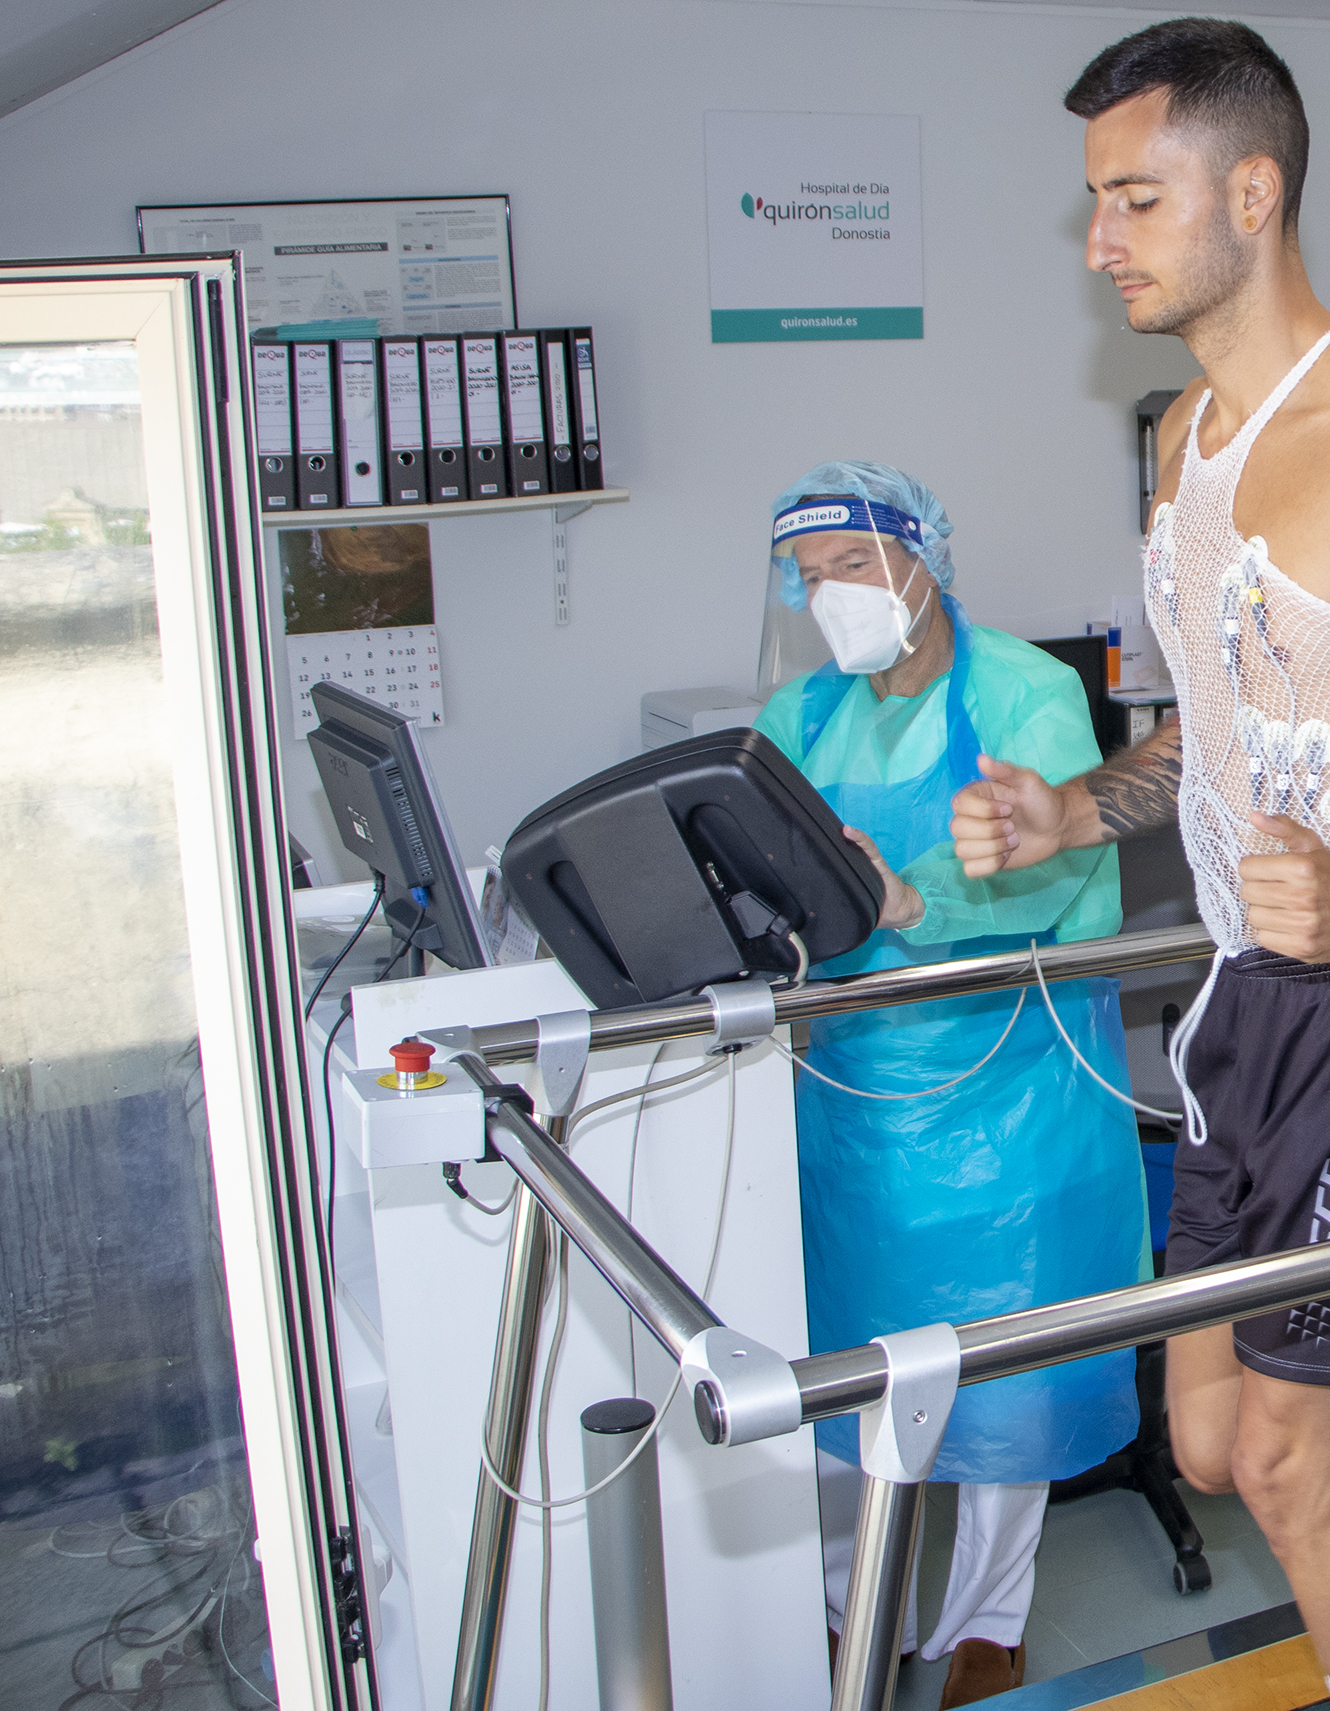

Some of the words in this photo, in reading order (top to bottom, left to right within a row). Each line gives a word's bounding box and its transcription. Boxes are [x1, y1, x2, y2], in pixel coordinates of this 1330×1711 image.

[800, 182, 850, 196] Hospital
[852, 183, 867, 194] de
[763, 200, 890, 226] quirónsalud
[832, 227, 890, 240] Donostia
[336, 242, 382, 252] ALIMENTARIA
[780, 316, 858, 328] quironsalud.es
[776, 519, 794, 534] Face
[798, 510, 842, 524] Shield
[321, 672, 331, 680] 13
[408, 665, 416, 673] 17
[366, 686, 376, 694] 22
